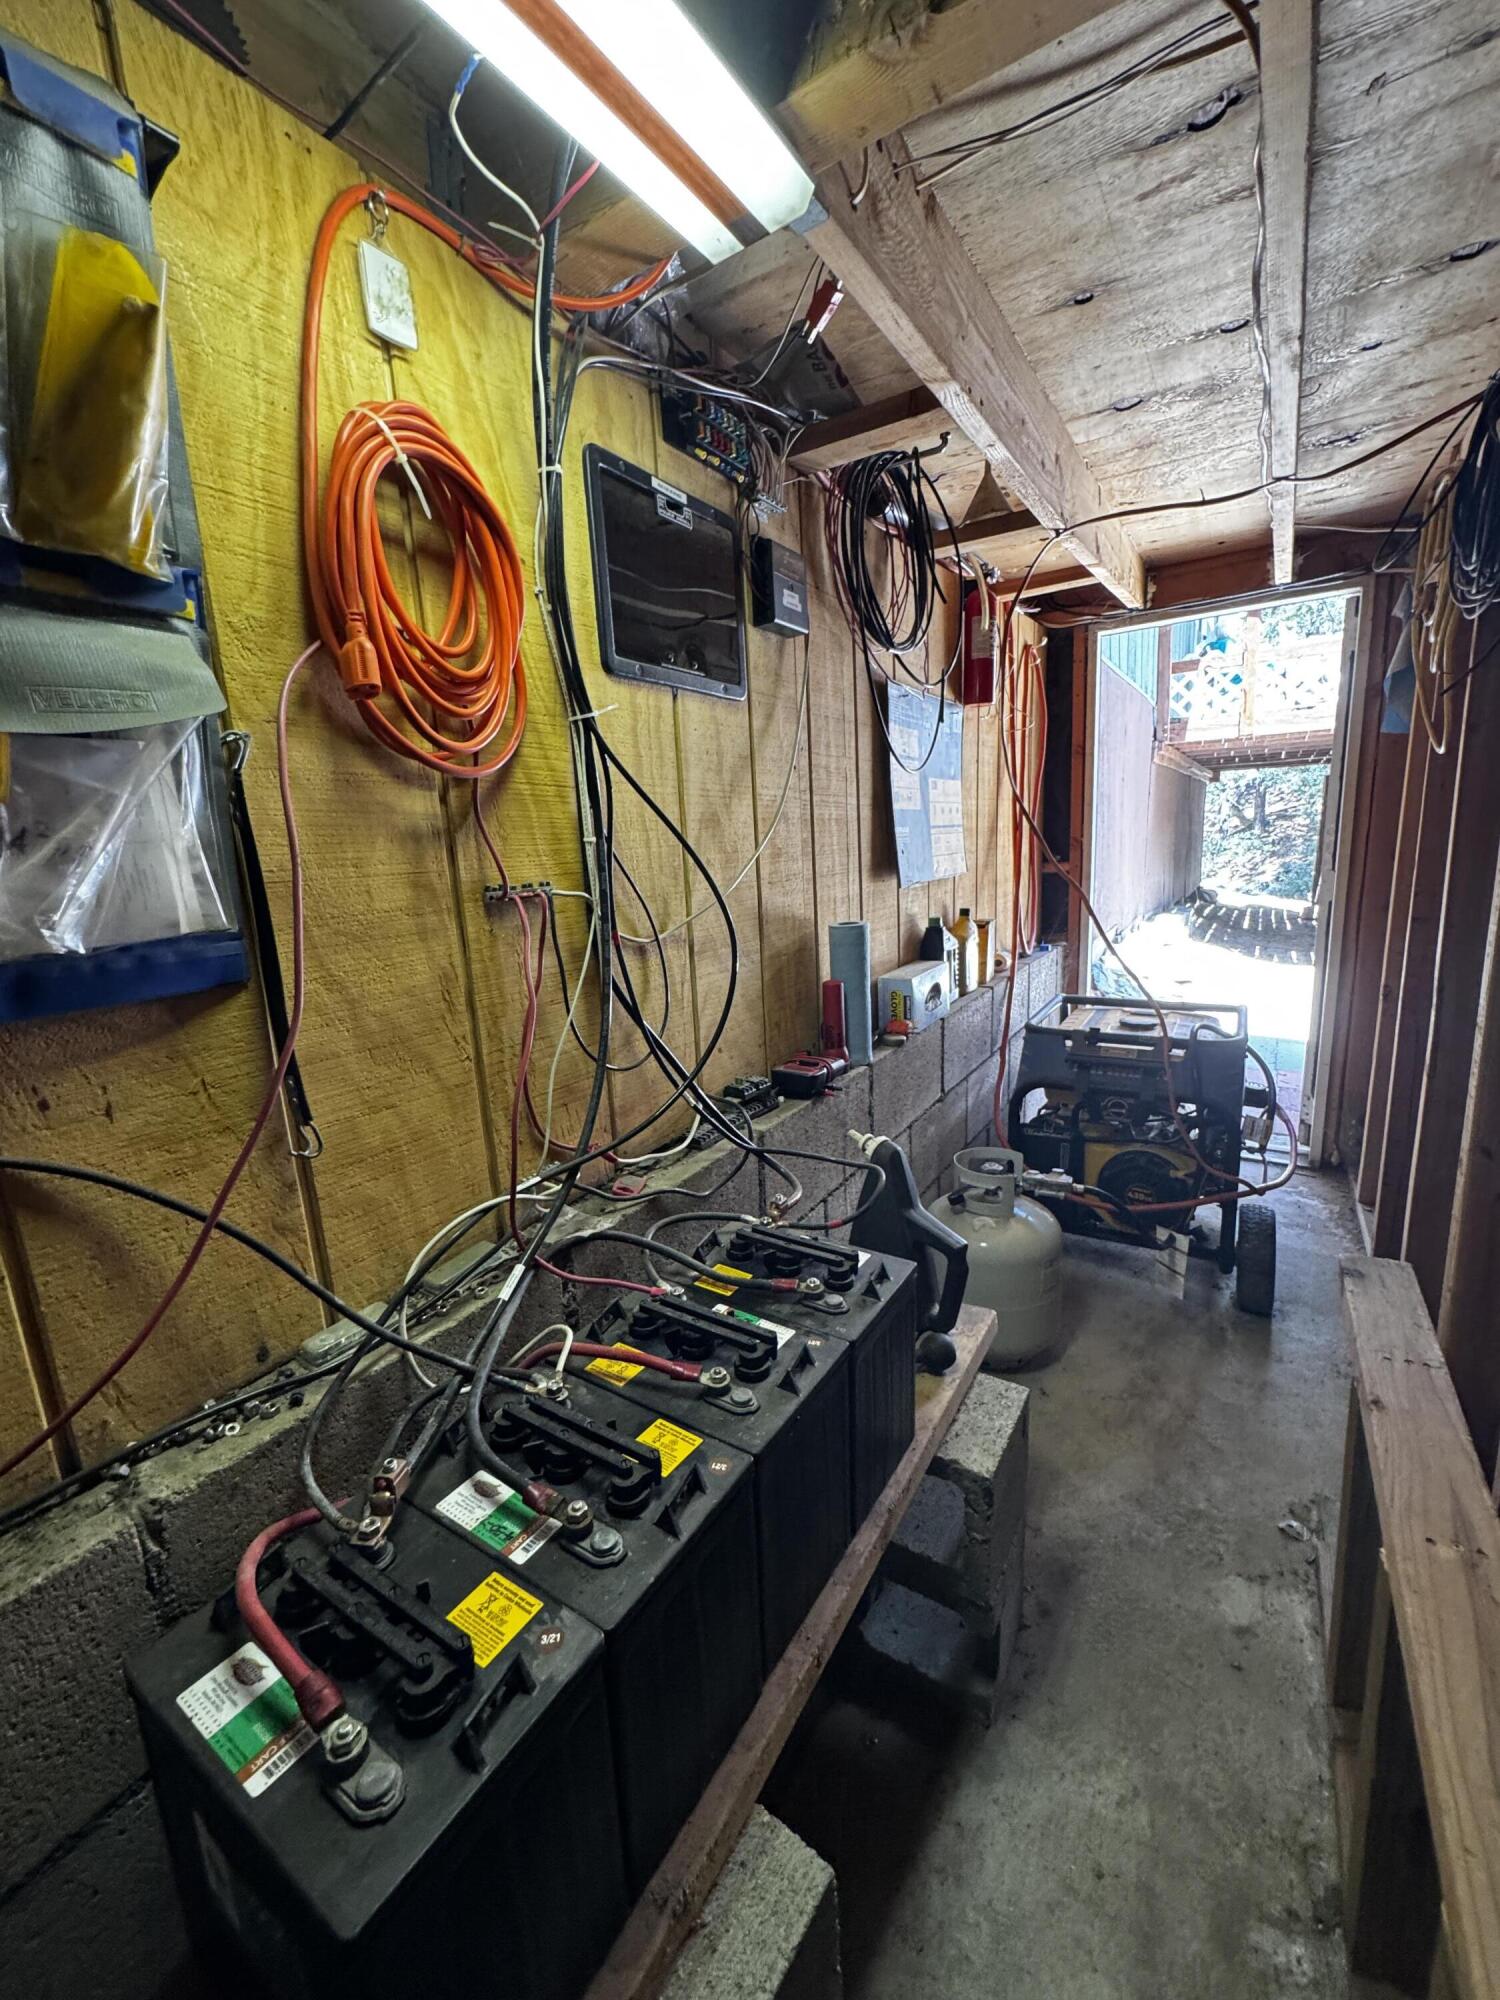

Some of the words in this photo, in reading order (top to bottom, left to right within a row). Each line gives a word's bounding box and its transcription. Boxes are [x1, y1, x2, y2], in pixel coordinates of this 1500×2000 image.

[33, 690, 149, 712] VELCRO
[540, 1631, 561, 1645] 3/21
[250, 1745, 278, 1773] CART
